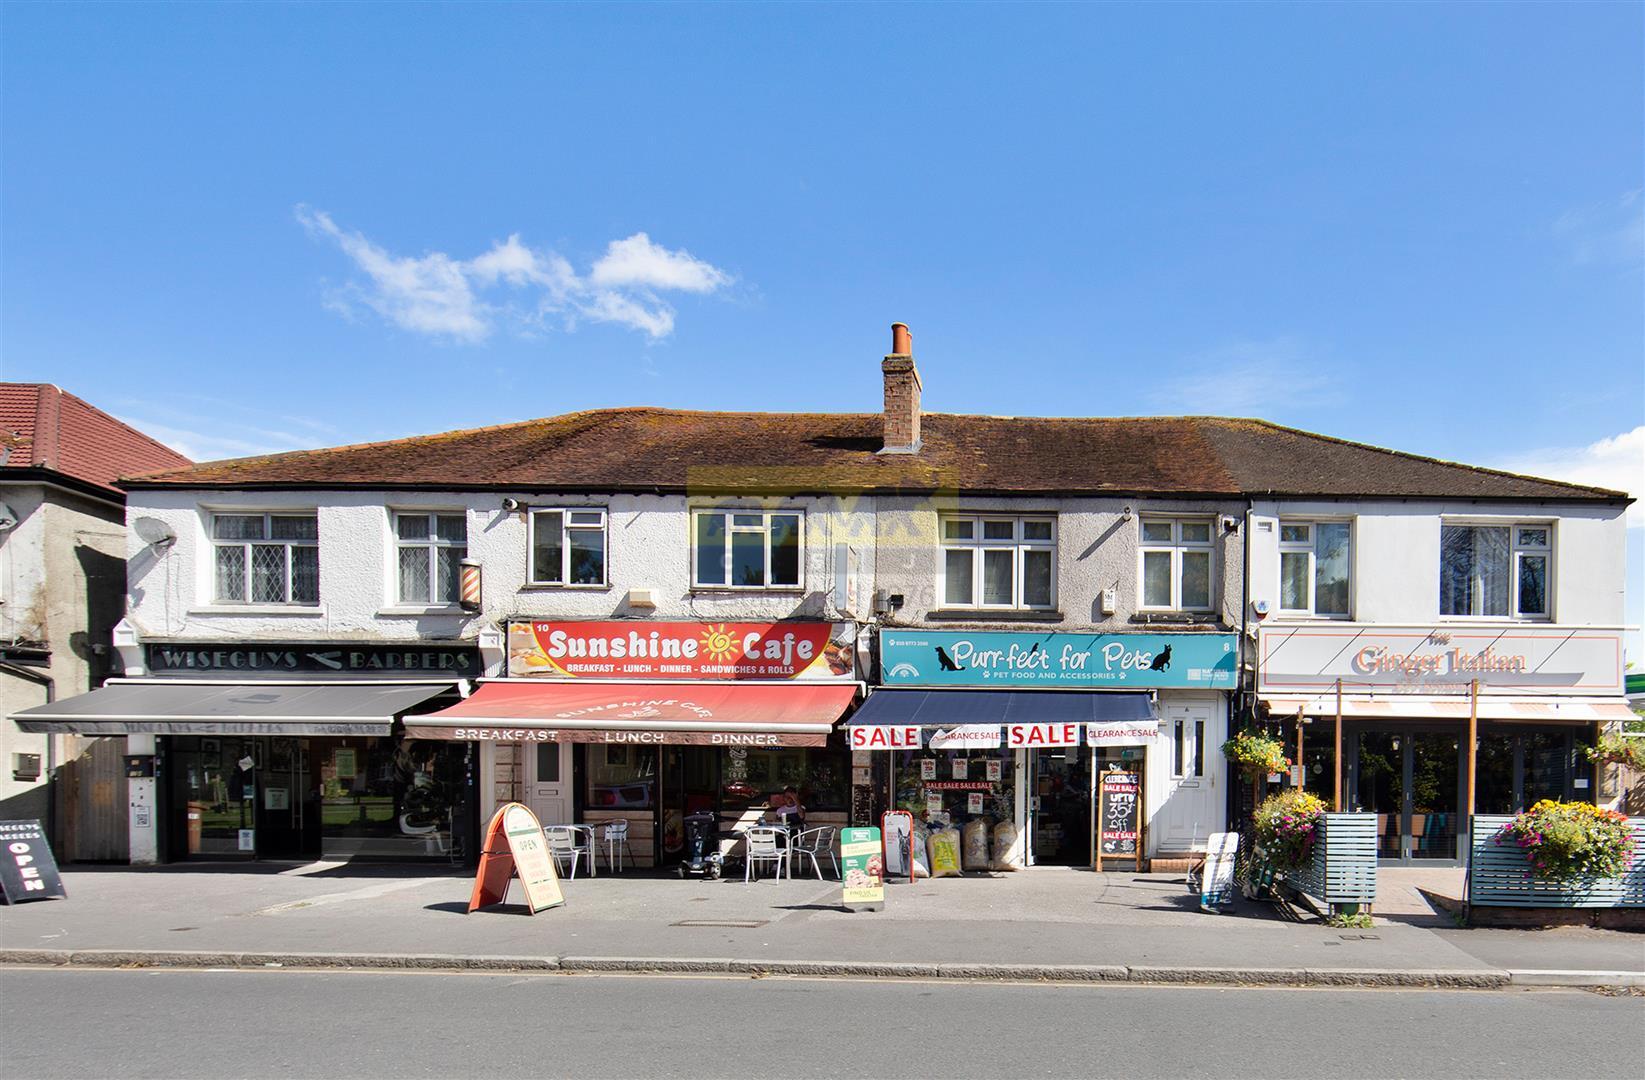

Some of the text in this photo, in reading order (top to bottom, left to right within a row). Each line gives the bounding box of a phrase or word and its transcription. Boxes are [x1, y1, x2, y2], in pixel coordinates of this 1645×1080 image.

[537, 624, 549, 632] 10
[548, 630, 814, 666] Sunshine Cafe
[951, 640, 1050, 670] Purr-fect
[1059, 643, 1092, 670] for
[1101, 642, 1152, 671] Pets
[1223, 642, 1230, 651] 8
[161, 650, 470, 670] WISEGUYS BARBERS
[566, 663, 614, 673] BREAKFAST
[623, 664, 652, 673] LUNCH
[660, 664, 692, 674] DINNER
[701, 665, 758, 674] SANDWICHES
[759, 666, 765, 674] &
[768, 666, 794, 674] ROLLS
[1357, 645, 1527, 677] Ginger Italian
[1059, 672, 1116, 680] ACCESSORIES
[556, 699, 713, 718] SUNSHINE CAFE
[455, 729, 779, 745] BREAKFAST LUNCH DINNER
[853, 727, 918, 746] SALE
[980, 731, 1000, 740] SALE
[1012, 725, 1158, 744] SALE CLEARANCE SALE
[519, 839, 538, 851] OPEN
[8, 842, 46, 892] OPEN
